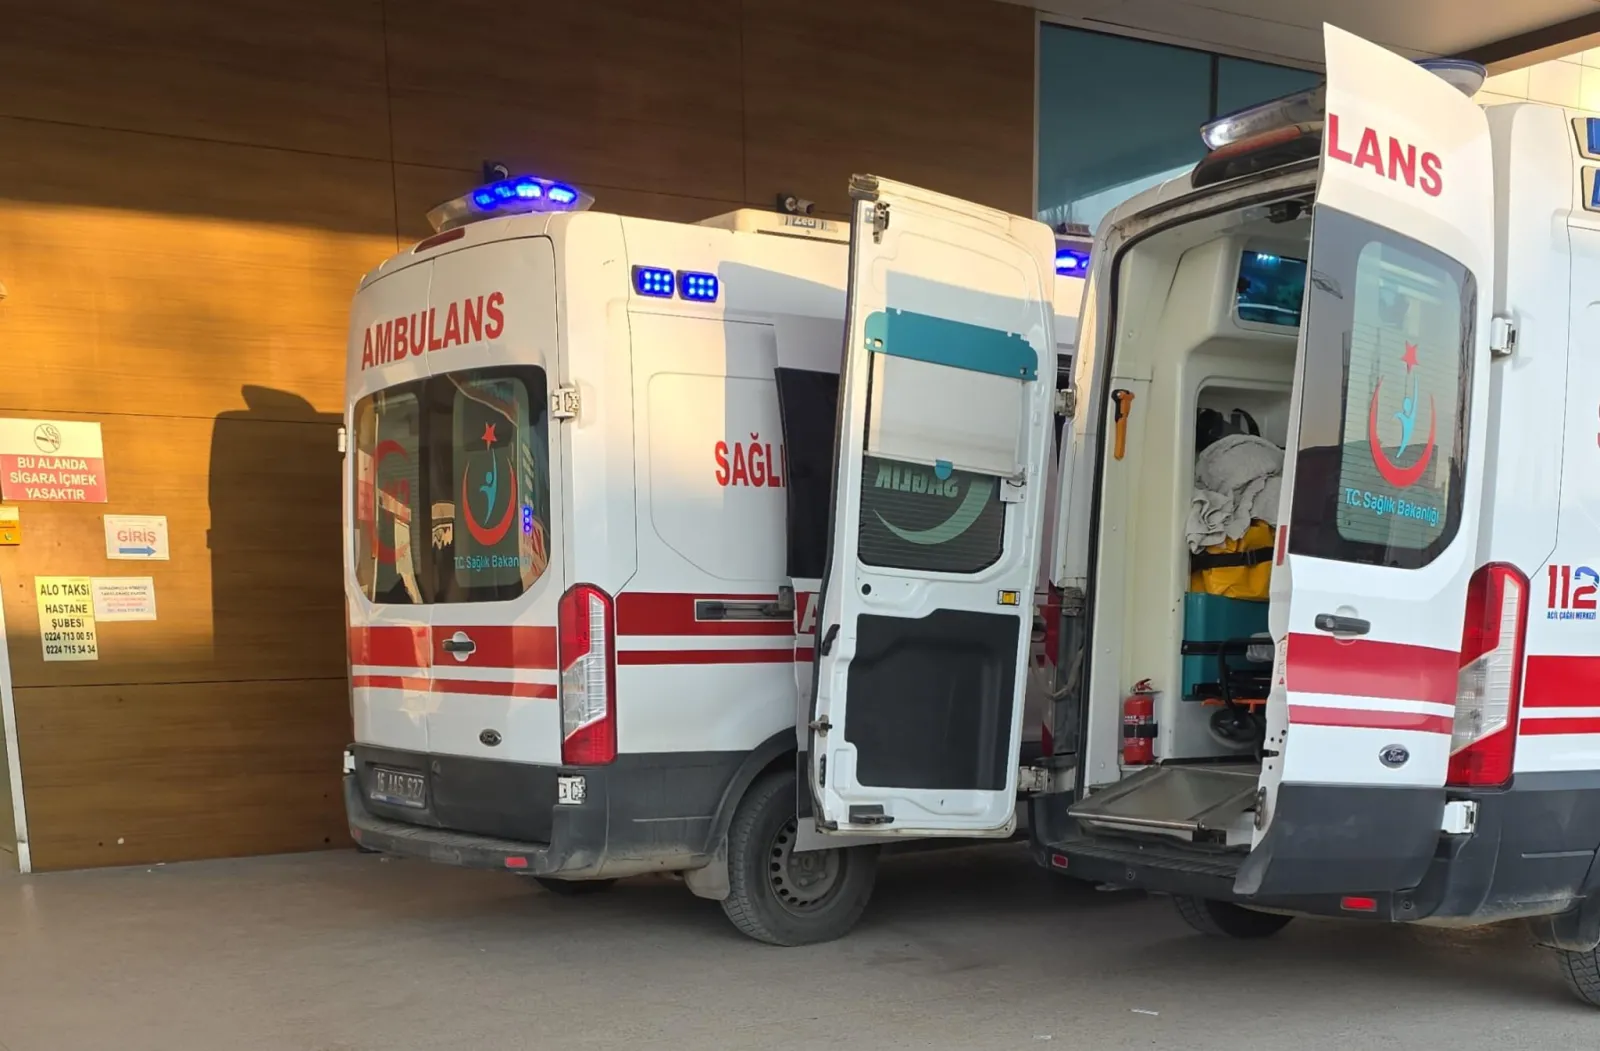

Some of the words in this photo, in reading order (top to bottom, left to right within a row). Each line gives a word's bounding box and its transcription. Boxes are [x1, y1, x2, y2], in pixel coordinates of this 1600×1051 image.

[1327, 112, 1442, 197] LANS
[361, 291, 504, 371] AMBULANS
[17, 456, 35, 468] BU
[38, 458, 88, 471] ALANDA
[10, 469, 57, 484] SİGARA
[59, 471, 97, 487] İÇMEK
[25, 487, 86, 500] YASAKTIR
[1363, 491, 1395, 515] Sağlık
[1397, 499, 1440, 527] Bakanlığı
[117, 528, 156, 545] GİRİŞ
[40, 584, 59, 596] ALO
[1547, 565, 1599, 609] 112
[45, 604, 88, 614] HASTANE
[44, 632, 61, 641] 0224
[62, 632, 75, 641] 713
[46, 645, 62, 654] 0224
[64, 645, 76, 654] 715
[78, 645, 86, 654] 34
[87, 645, 96, 654] 34
